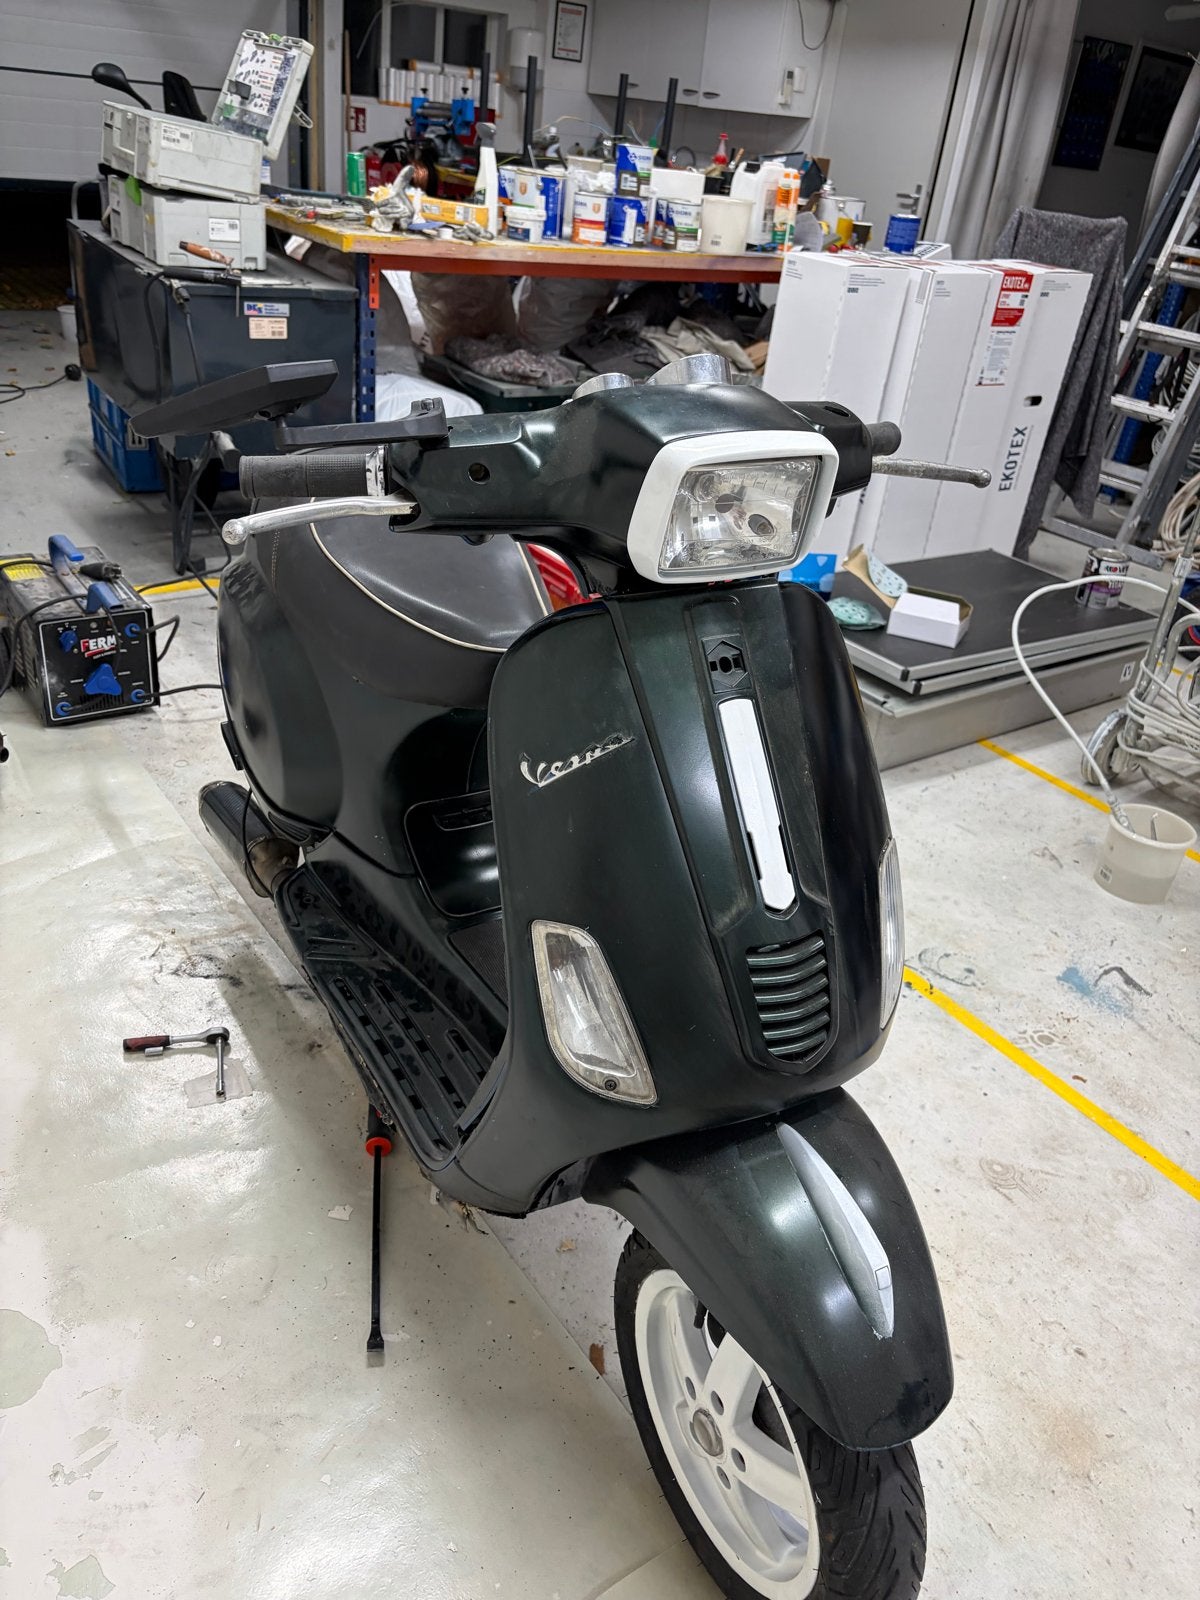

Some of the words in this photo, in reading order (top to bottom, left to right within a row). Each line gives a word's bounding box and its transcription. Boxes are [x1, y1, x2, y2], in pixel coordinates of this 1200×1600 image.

[1002, 276, 1027, 289] EKOTEX
[998, 426, 1028, 492] EKOTEX
[80, 634, 117, 653] FERM
[520, 732, 636, 789] Vespa
